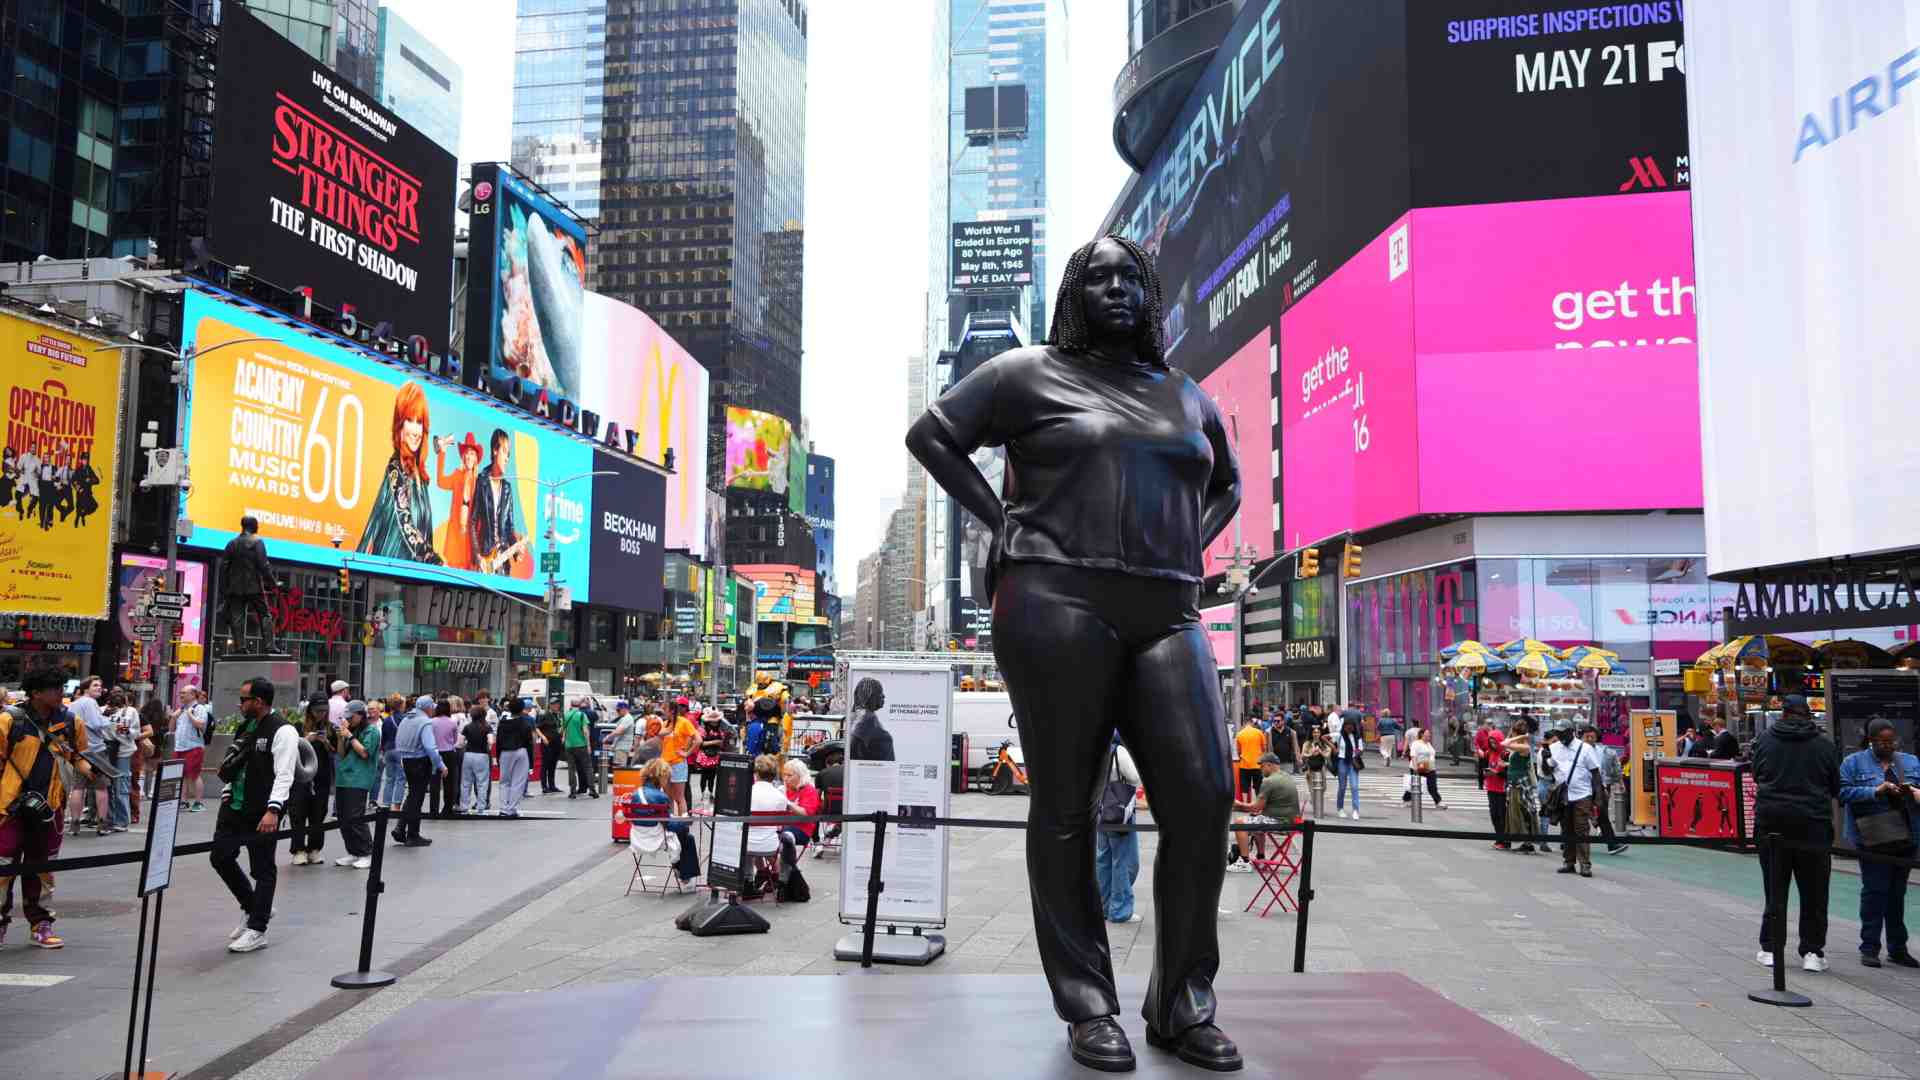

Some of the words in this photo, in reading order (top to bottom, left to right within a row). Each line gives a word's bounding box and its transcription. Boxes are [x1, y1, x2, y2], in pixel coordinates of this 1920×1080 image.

[1447, 17, 1539, 43] SURPRISE
[1543, 1, 1672, 34] INSPECTIONS
[1515, 48, 1591, 93] MAY
[1602, 44, 1637, 86] 21
[312, 70, 332, 94] LIVE
[333, 82, 349, 105] ON
[349, 93, 398, 137] BROADWAY
[1160, 0, 1285, 210] SERVICE
[1792, 47, 1920, 165] AIRF
[273, 105, 419, 234] STRANGER
[297, 164, 399, 253] THINGS
[474, 203, 490, 215] LG
[270, 196, 305, 236] THE
[310, 216, 357, 261] FIRST
[358, 243, 418, 292] SHADOW
[954, 238, 984, 247] Ended
[997, 236, 1030, 246] Europe
[964, 227, 992, 236] World
[994, 225, 1012, 235] War
[1014, 224, 1021, 233] II
[961, 262, 980, 272] May
[982, 261, 999, 270] 8th,
[1002, 260, 1024, 269] 1945
[962, 249, 973, 258] 80
[975, 248, 1001, 257] Years
[1003, 247, 1022, 258] Ago
[1293, 259, 1317, 285] MARRIOTT
[972, 274, 989, 283] V-E
[992, 273, 1013, 283] DAY
[1209, 287, 1226, 332] MAY
[1227, 278, 1235, 316] 21
[1236, 251, 1260, 307] FOX
[1269, 240, 1292, 276] hulu
[1293, 274, 1316, 299] MARQUIS
[1552, 280, 1638, 331] get
[1646, 276, 1696, 317] th
[233, 357, 304, 414] ACADEMY
[1302, 356, 1324, 403] get
[1325, 344, 1349, 381] the
[9, 386, 96, 436] OPERATION
[230, 407, 303, 461] COUNTRY
[303, 386, 364, 510] 60
[1352, 414, 1369, 453] 16
[229, 447, 301, 482] MUSIC
[228, 472, 301, 498] AWARDS
[544, 491, 584, 528] prime
[604, 511, 656, 543] BECKHAM
[620, 538, 640, 555] BOSS
[777, 515, 785, 547] 1500
[428, 589, 509, 631] FOREVER
[1735, 566, 1920, 620] AMERICA
[270, 588, 345, 646] Disney
[47, 642, 72, 650] SONY
[447, 657, 480, 674] FOREVER
[531, 647, 545, 657] POLO
[1285, 640, 1325, 660] SEPHORA
